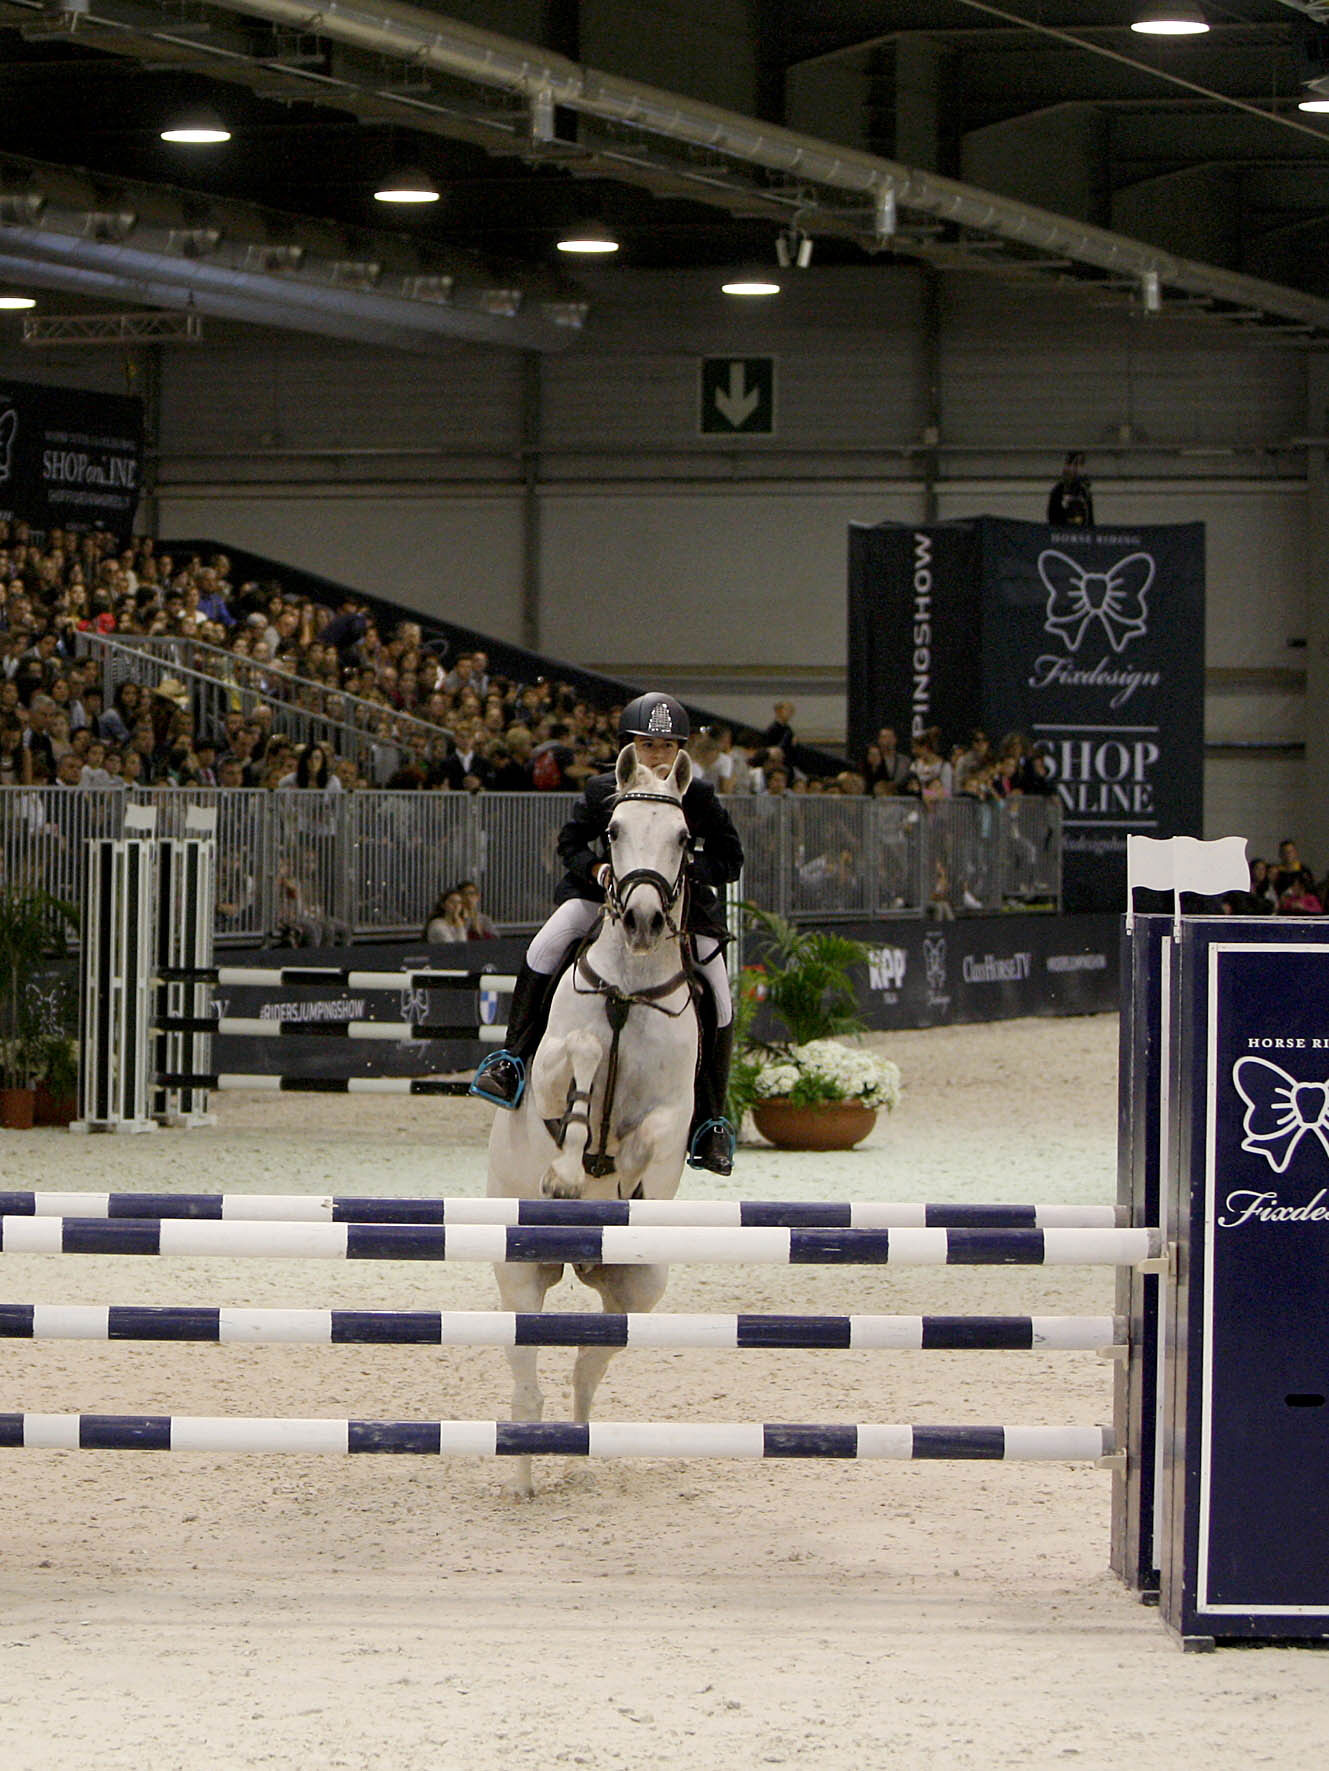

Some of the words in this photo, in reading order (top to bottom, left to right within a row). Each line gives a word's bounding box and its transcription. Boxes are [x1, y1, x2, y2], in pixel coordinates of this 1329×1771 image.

[1029, 655, 1161, 709] Fixdesign
[1033, 740, 1160, 782] SHOP
[1056, 783, 1155, 813] NLINE
[1248, 1038, 1306, 1048] HORSE
